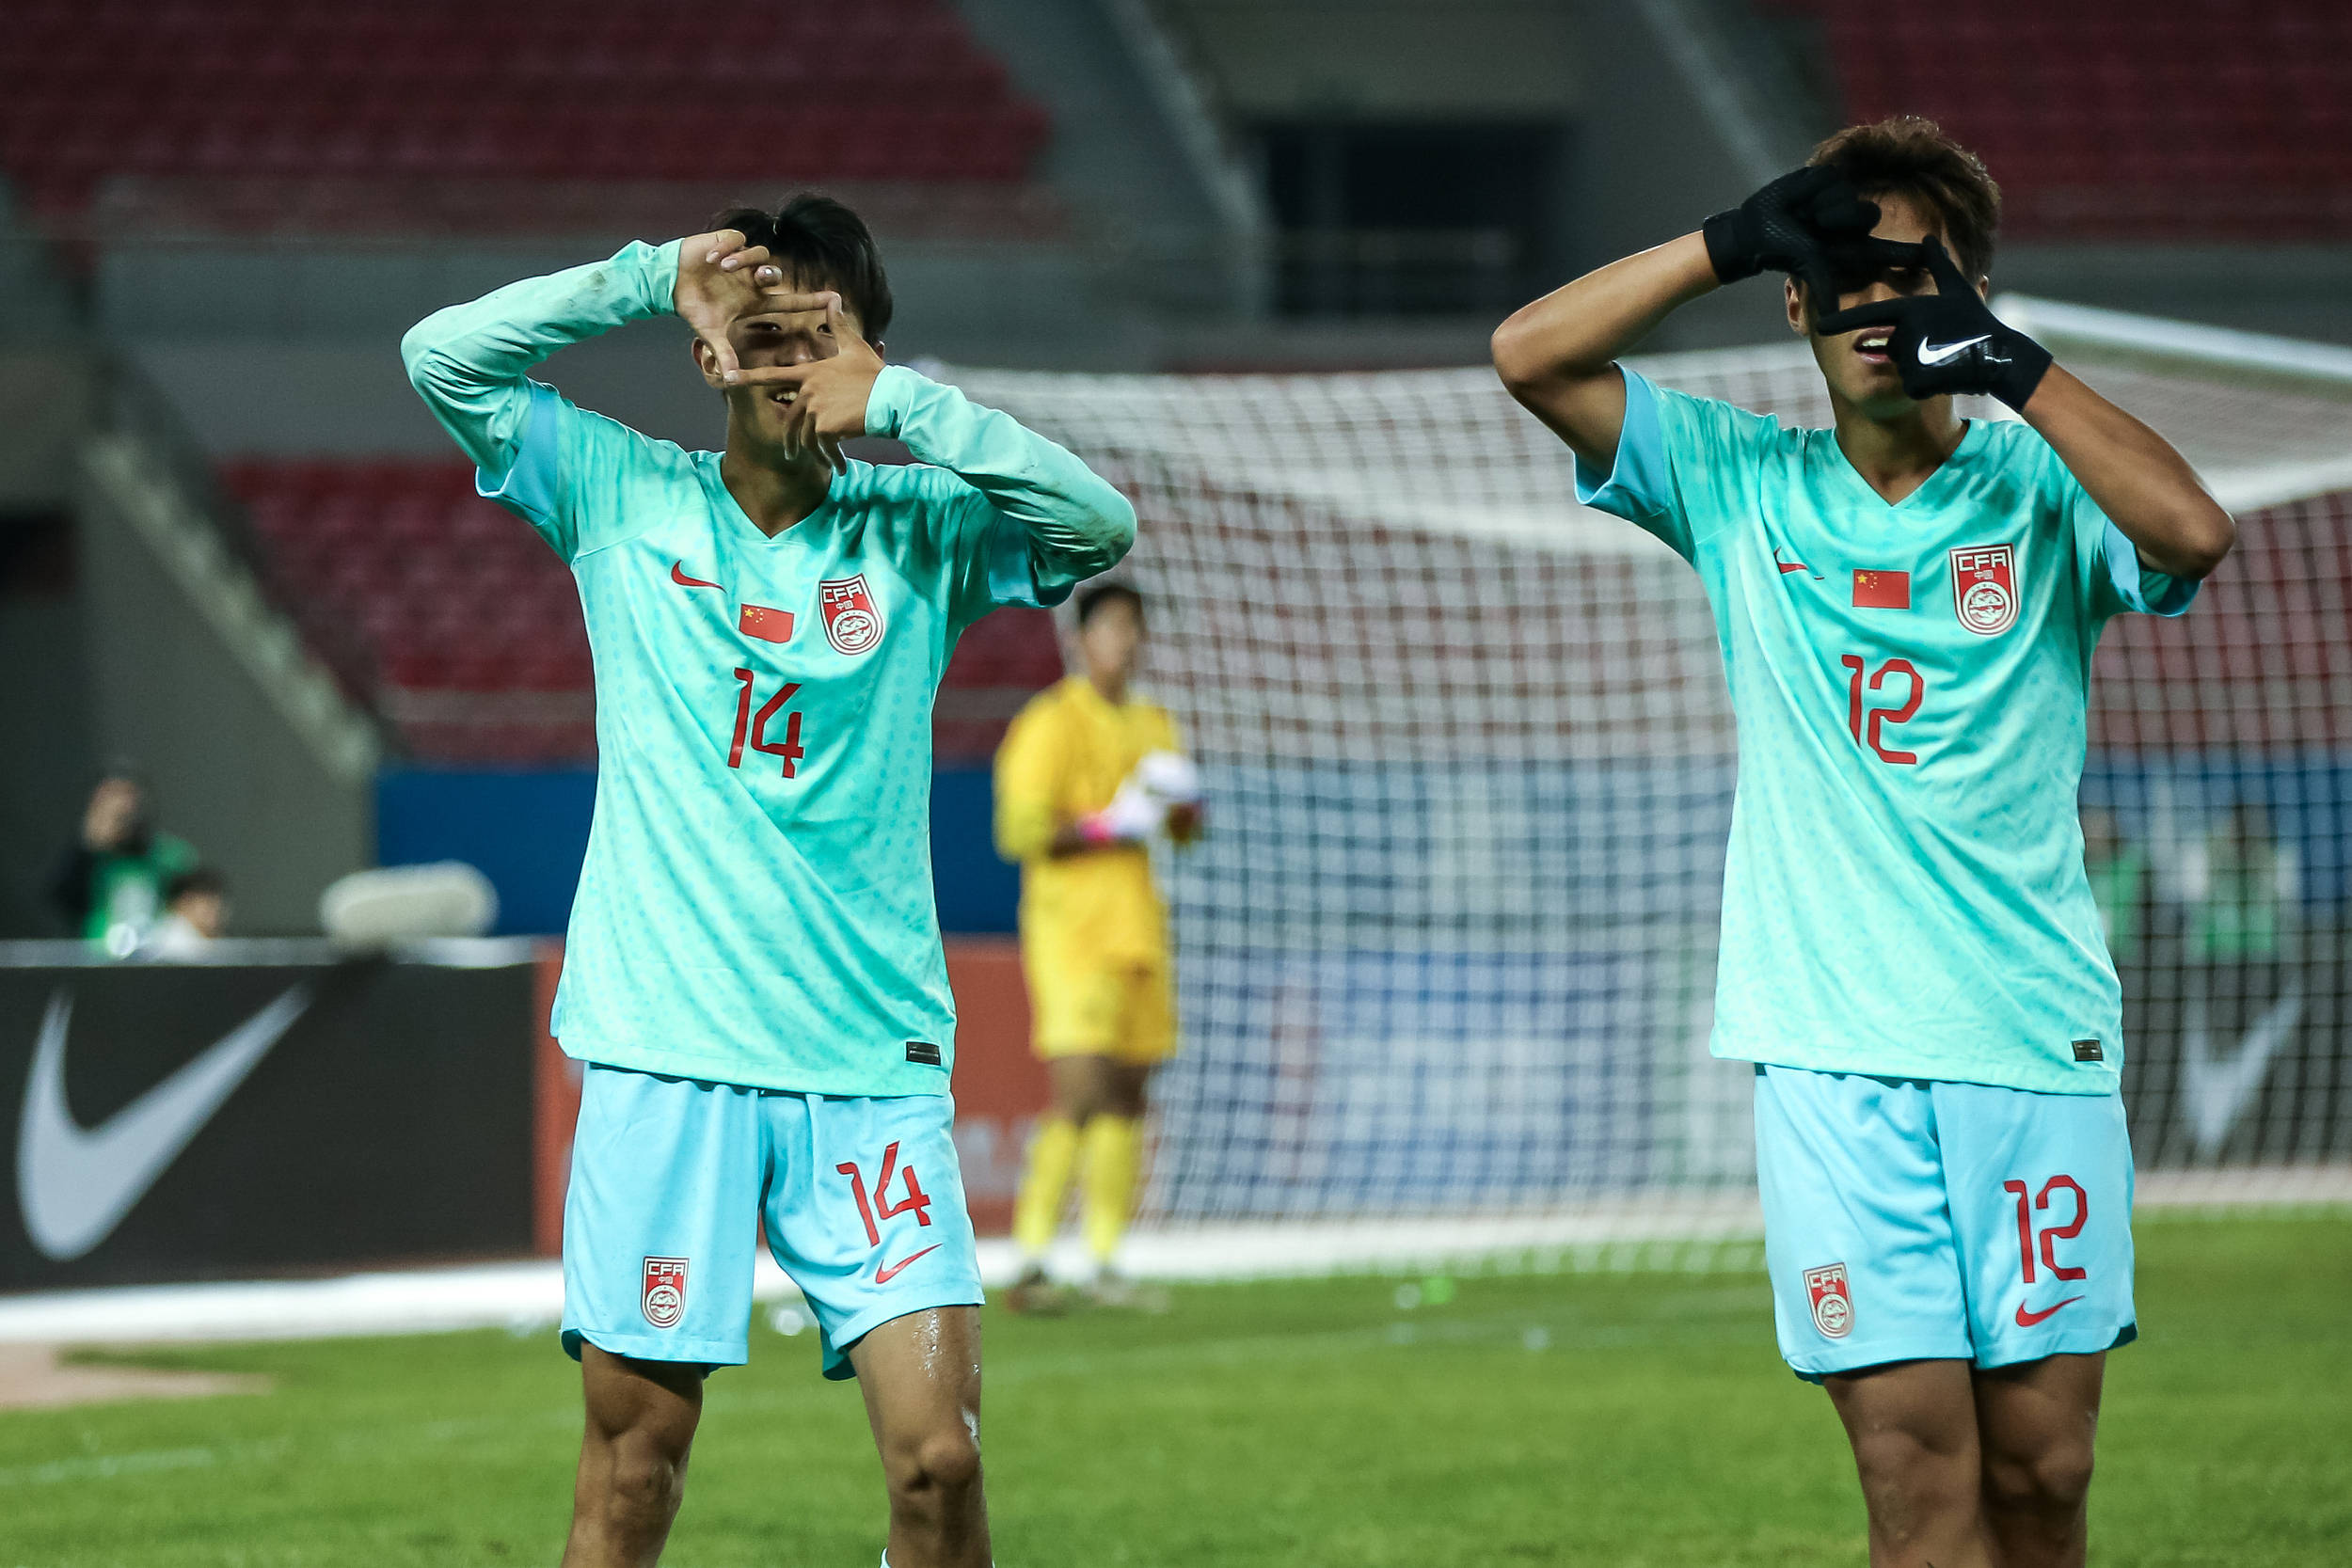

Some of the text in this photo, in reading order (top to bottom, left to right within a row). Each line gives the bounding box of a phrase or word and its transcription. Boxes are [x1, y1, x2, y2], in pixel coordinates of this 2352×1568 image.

[823, 583, 863, 603] CFA
[1958, 552, 2007, 571] CFA
[727, 667, 804, 779] 14
[1841, 654, 1924, 765] 12
[835, 1141, 930, 1247] 14
[2004, 1175, 2088, 1283] 12
[647, 1263, 685, 1275] CFA
[1809, 1270, 1844, 1288] CFA
